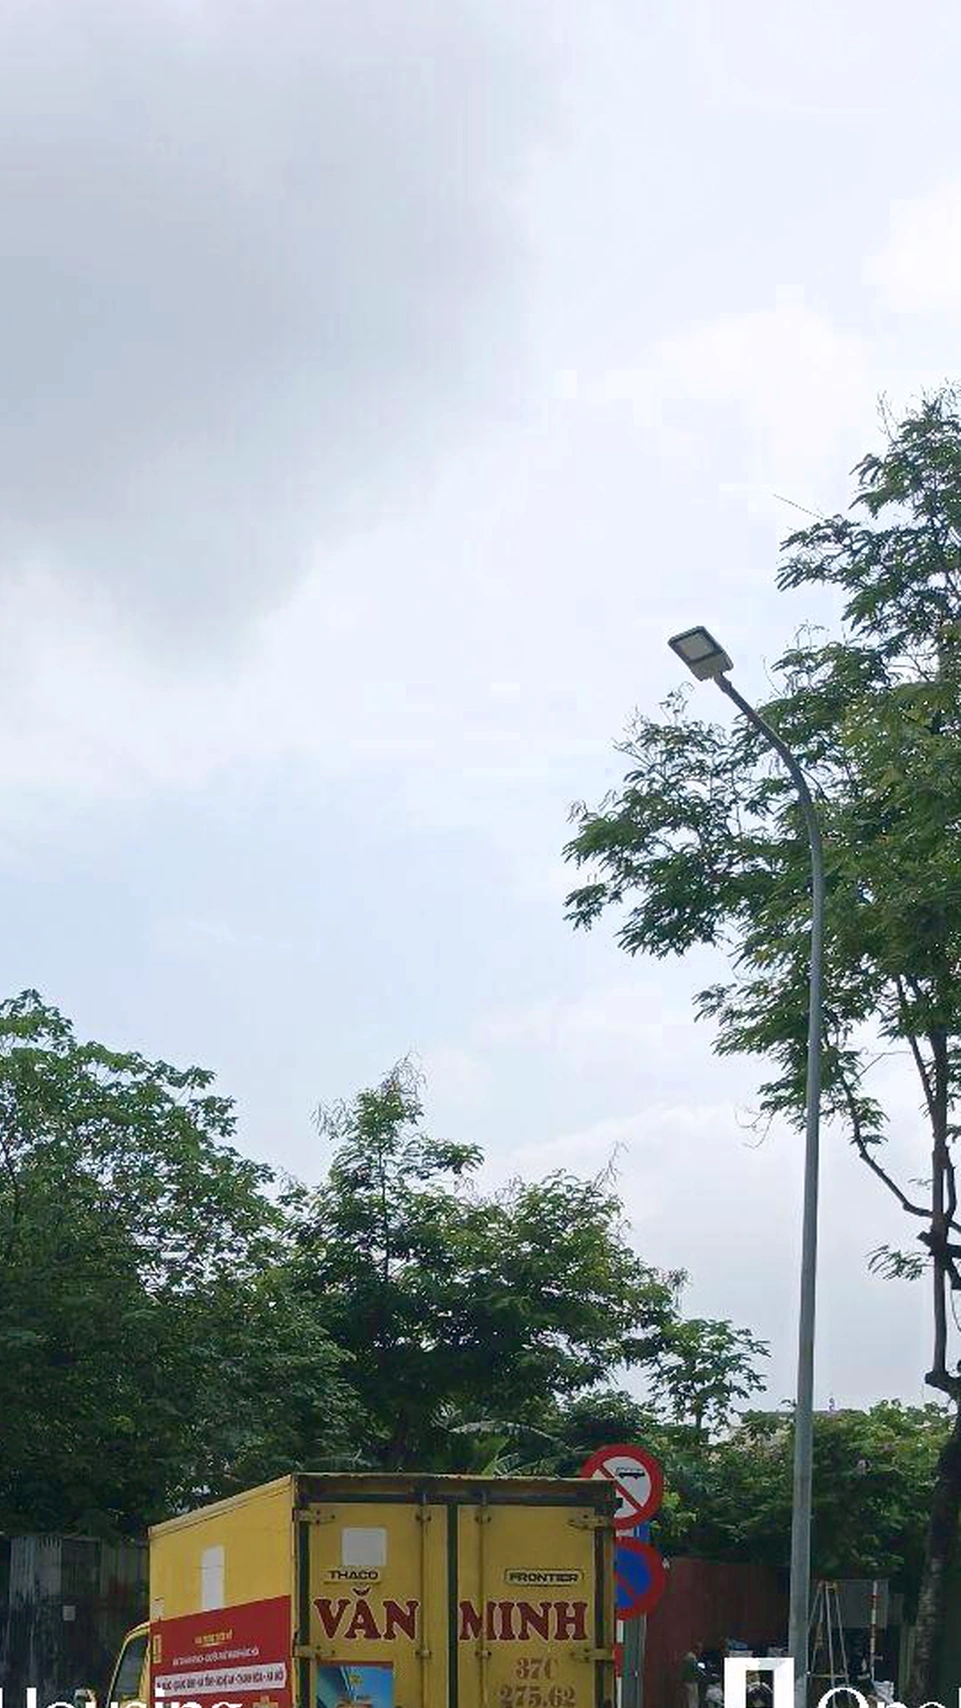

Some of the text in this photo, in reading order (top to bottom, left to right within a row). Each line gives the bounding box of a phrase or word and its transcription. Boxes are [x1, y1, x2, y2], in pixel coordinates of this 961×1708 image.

[329, 1569, 379, 1581] THACO
[508, 1571, 580, 1583] FRONTIER
[313, 1586, 588, 1642] VĂN MINH
[516, 1657, 559, 1680] 37C
[500, 1684, 576, 1708] 275.62
